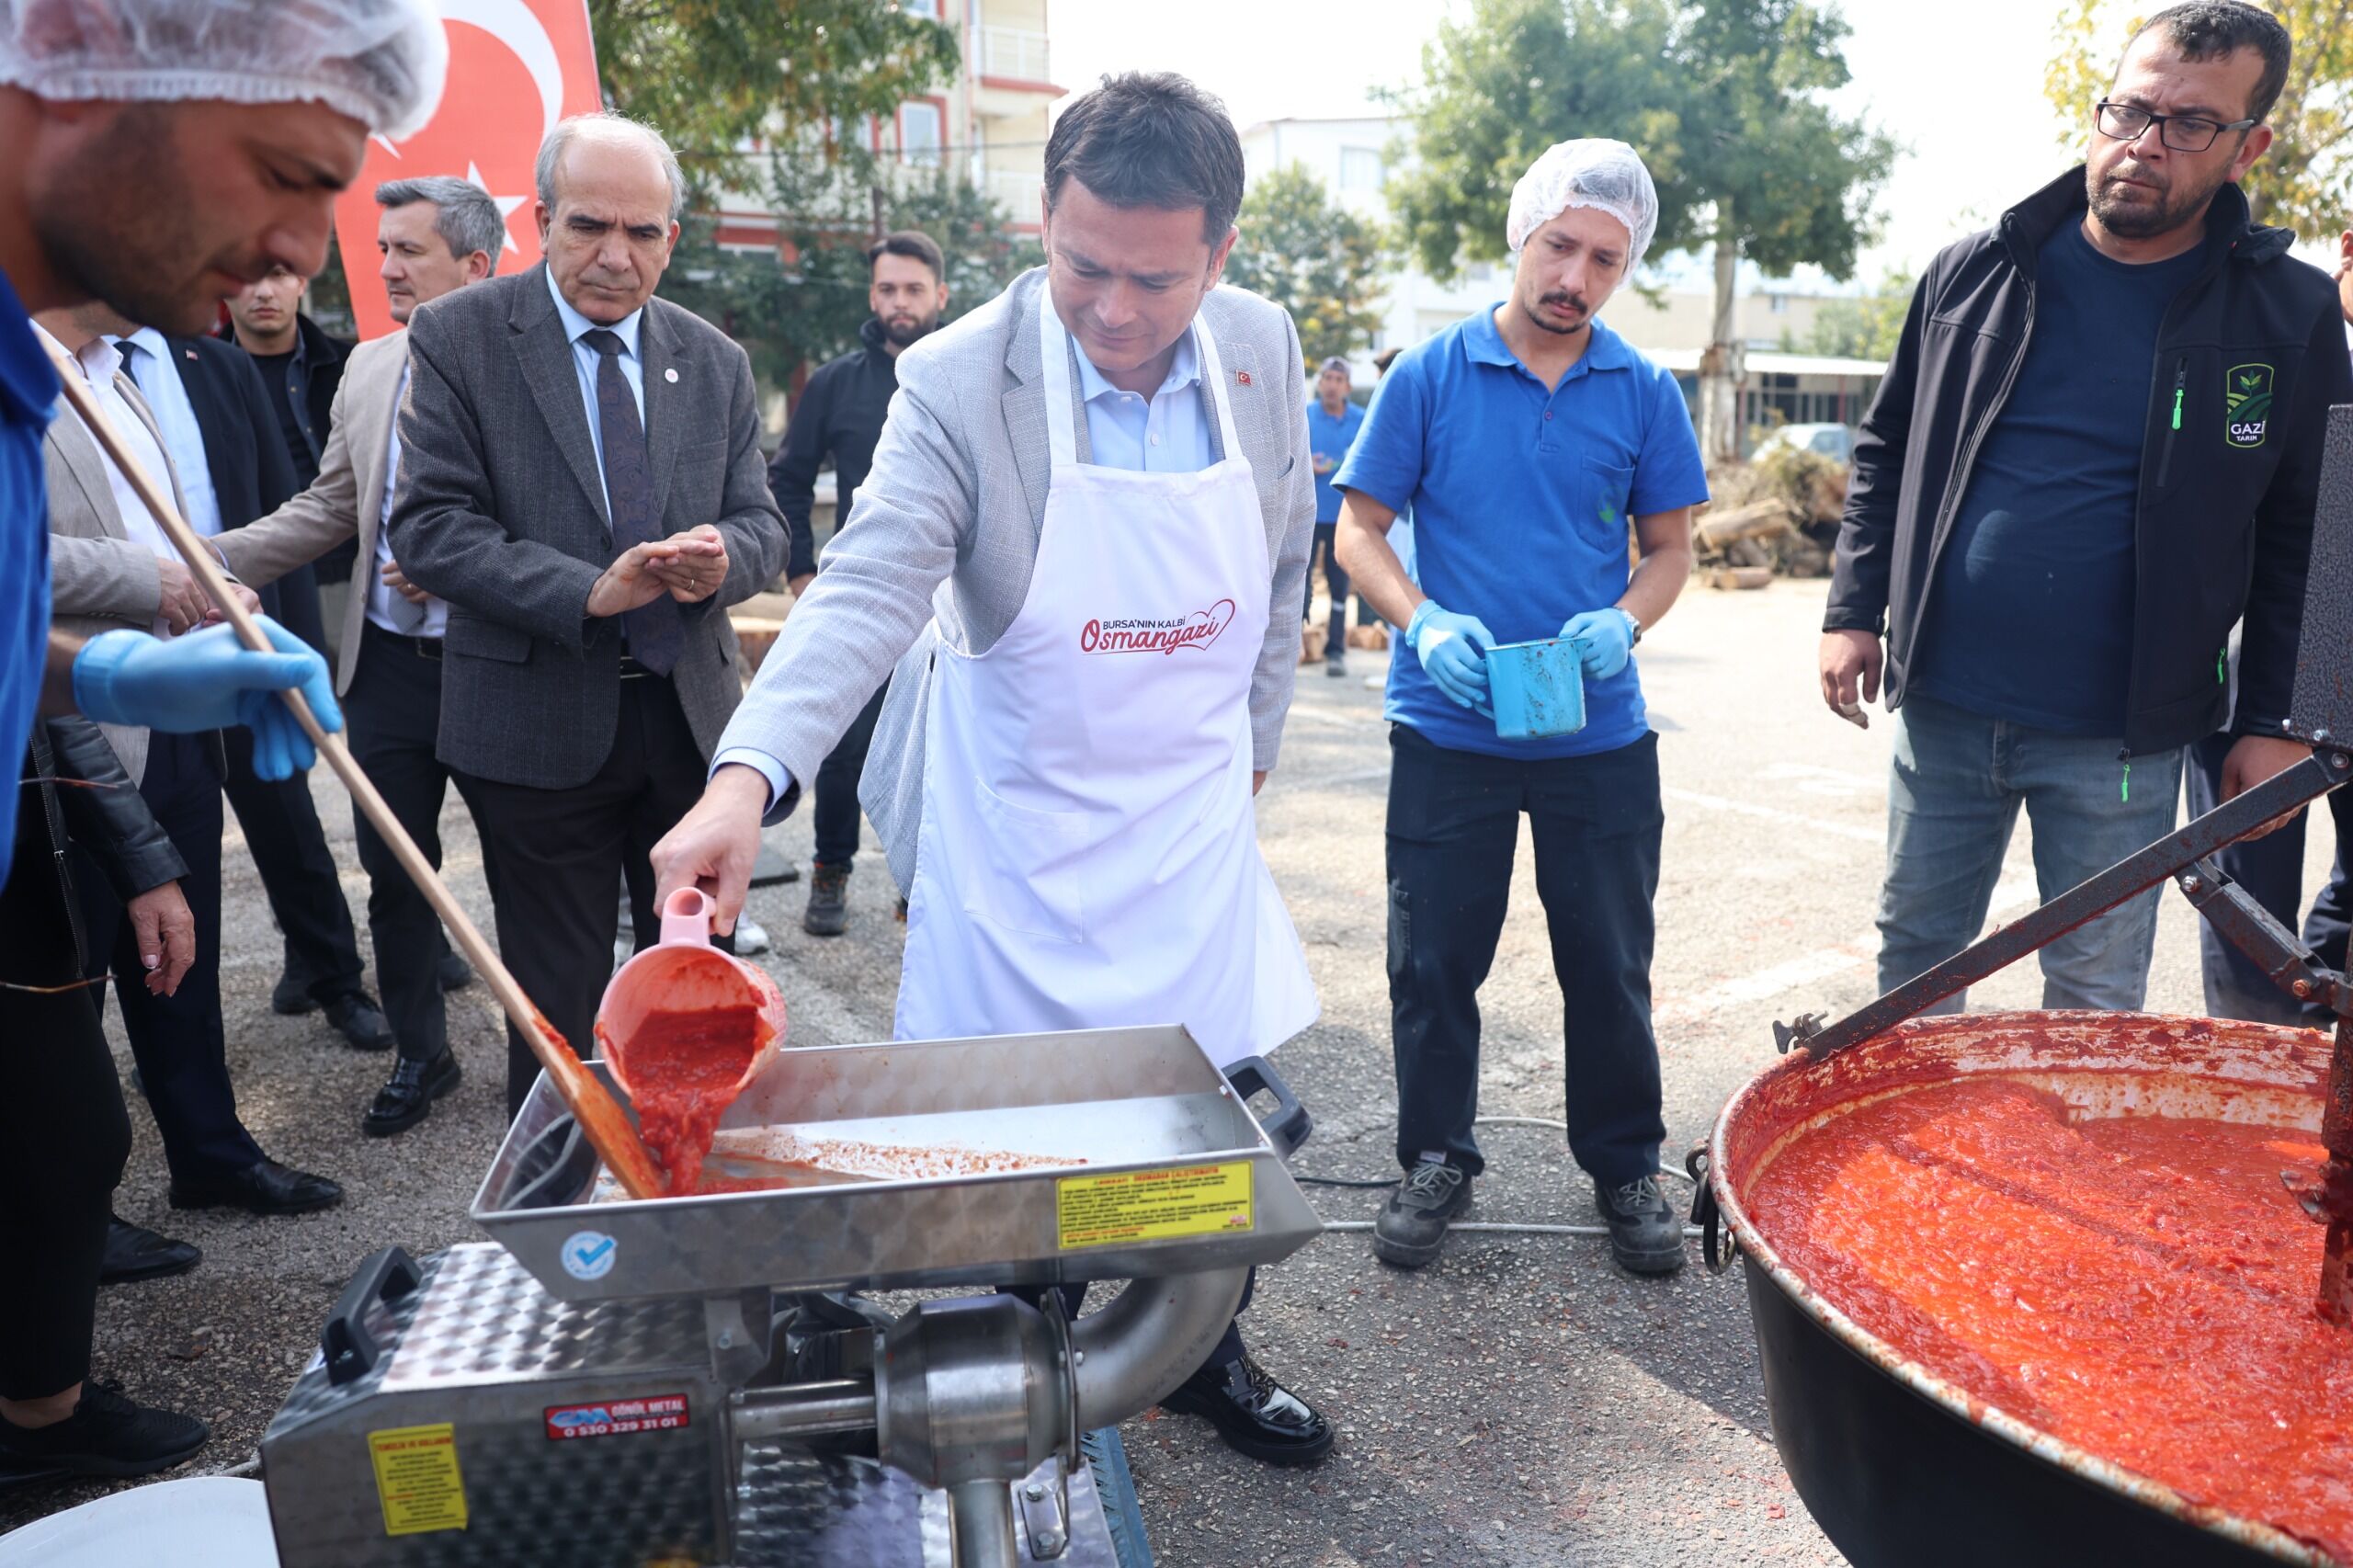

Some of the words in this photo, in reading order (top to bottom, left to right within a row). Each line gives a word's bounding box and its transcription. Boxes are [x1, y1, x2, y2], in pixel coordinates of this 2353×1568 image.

[1103, 619, 1156, 630] BURSA'NIN
[1157, 616, 1186, 629] KALBİ
[1081, 617, 1220, 655] Osmangazi
[648, 1399, 685, 1414] METAL
[579, 1424, 608, 1437] 530
[611, 1421, 639, 1433] 329
[642, 1418, 658, 1430] 31
[661, 1416, 677, 1428] 01
